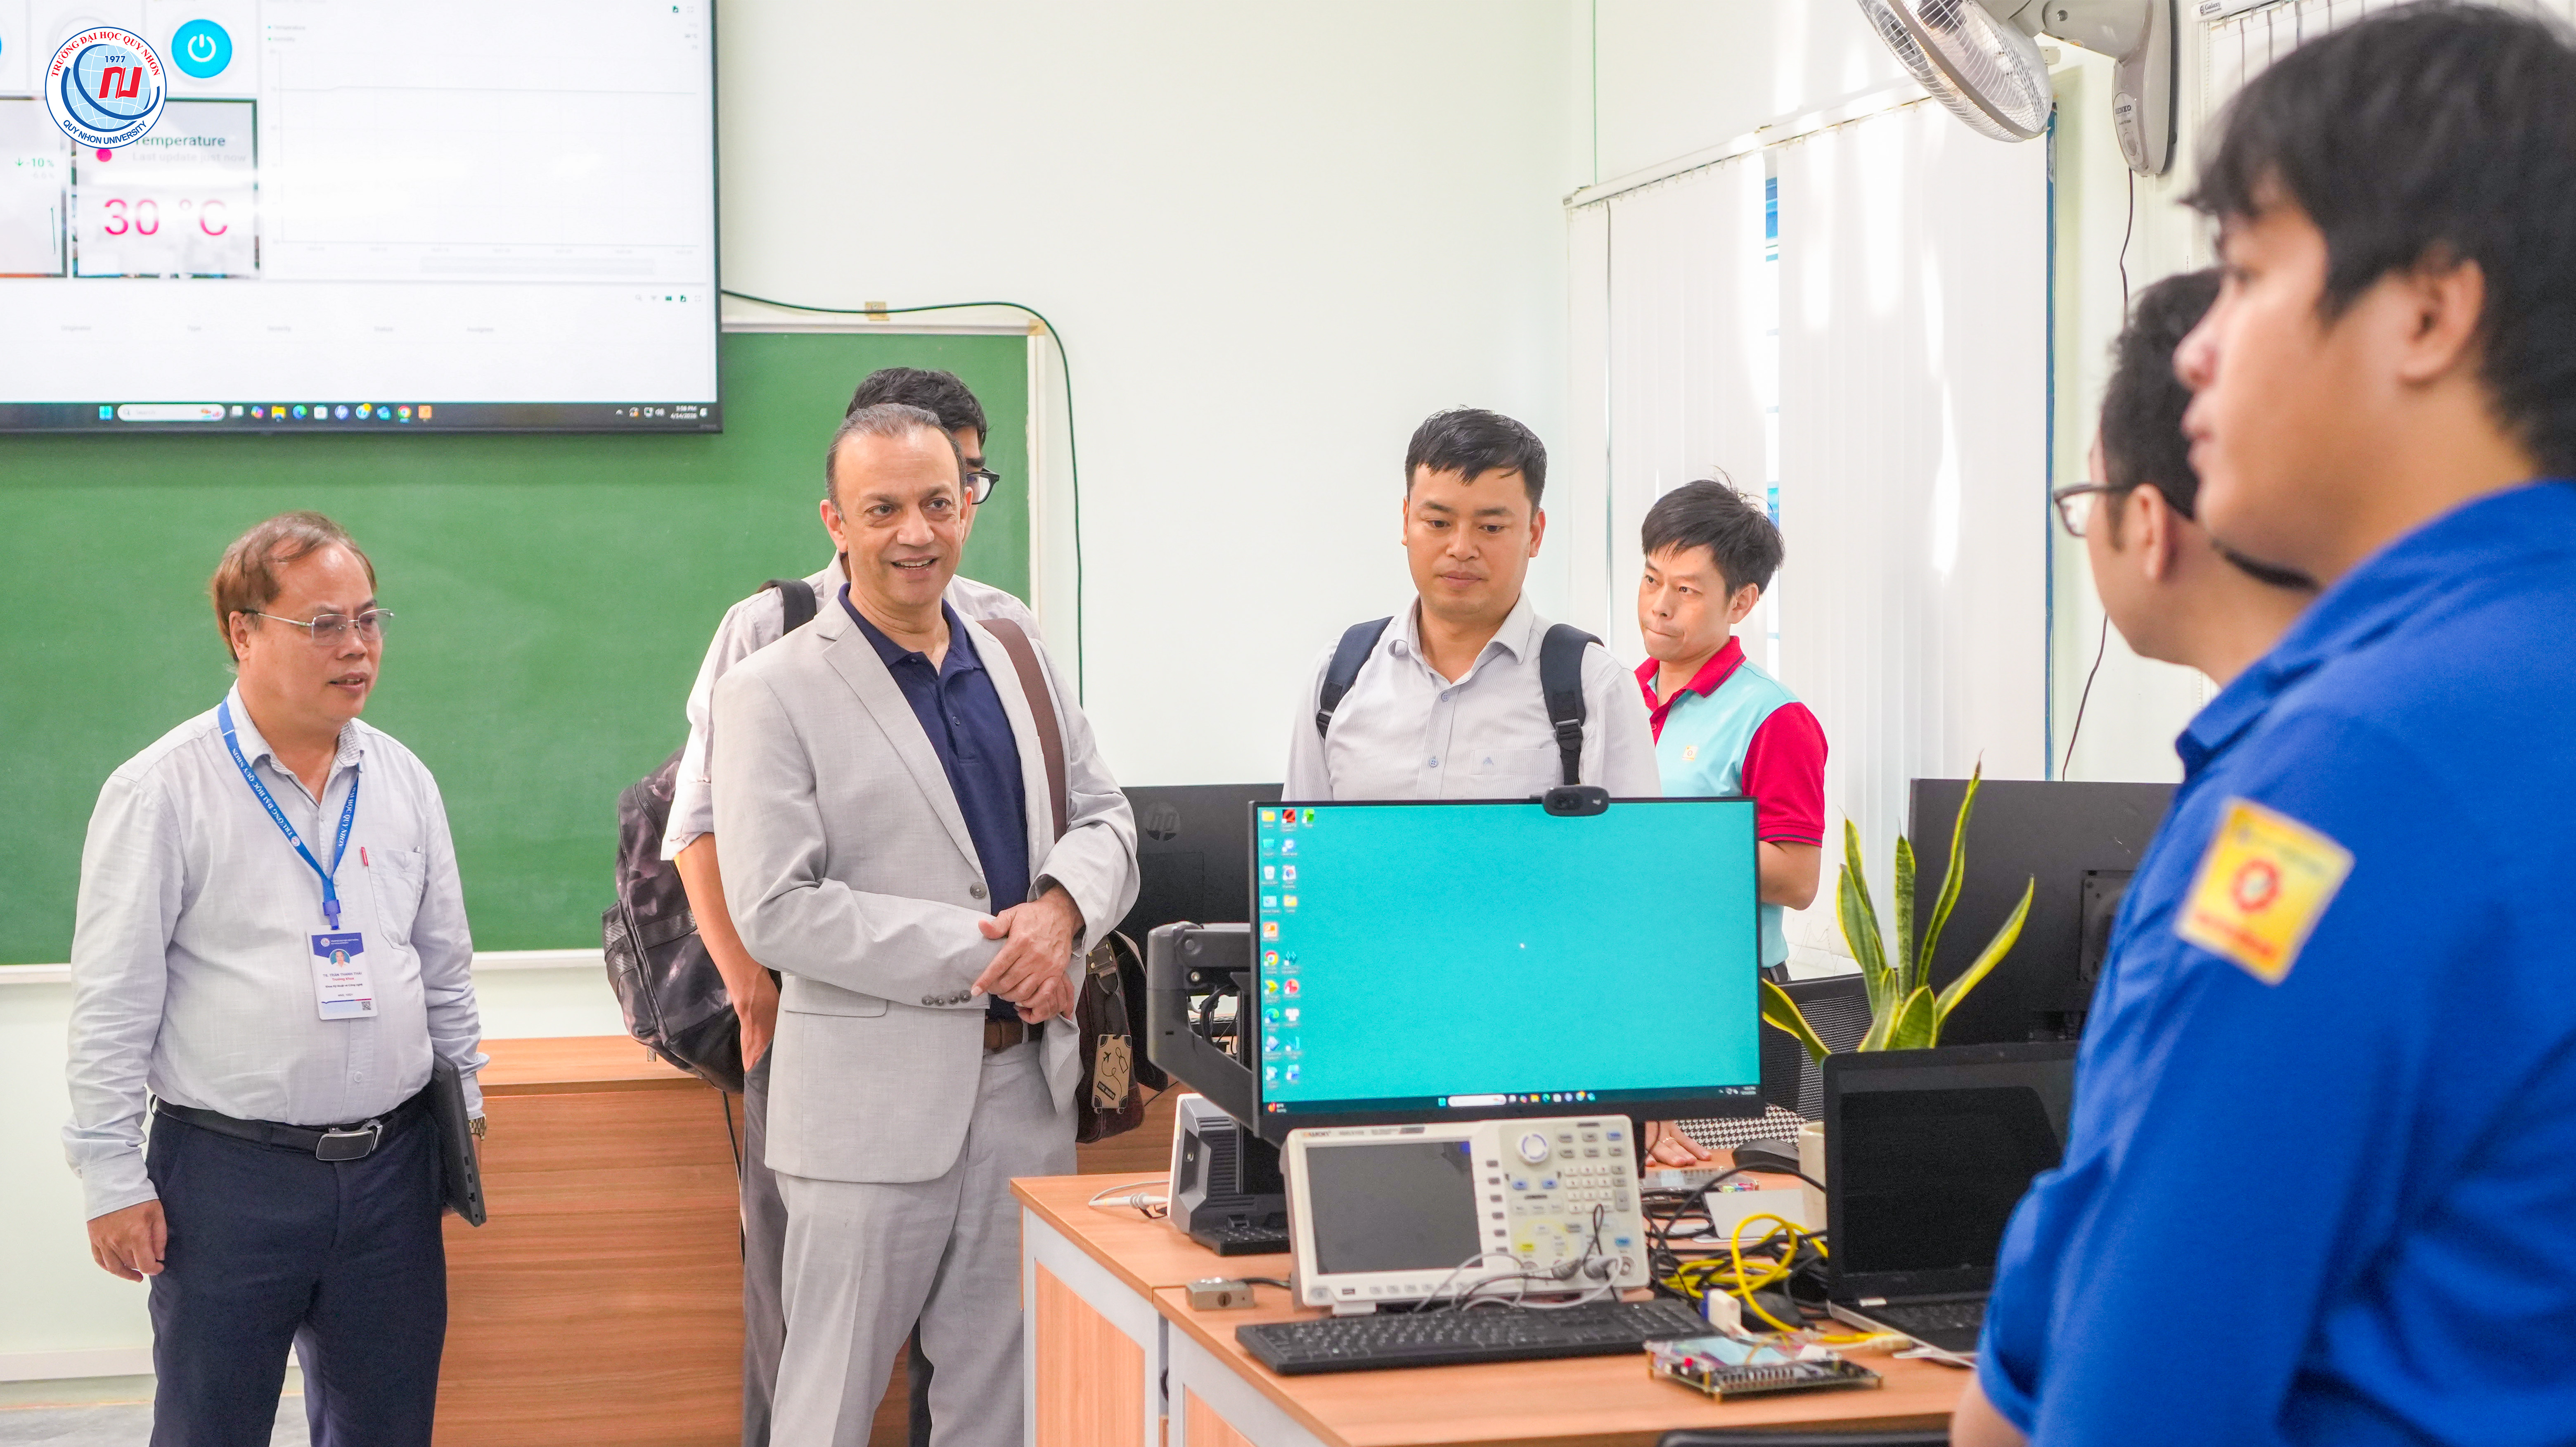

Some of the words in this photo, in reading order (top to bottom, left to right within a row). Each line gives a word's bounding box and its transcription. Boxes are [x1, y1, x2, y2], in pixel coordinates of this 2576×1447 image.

[2205, 2, 2221, 10] Galaxy
[133, 152, 156, 161] Last
[159, 152, 197, 163] update
[201, 153, 220, 163] just
[104, 198, 159, 236] 30
[179, 199, 228, 236] °C
[243, 768, 255, 782] QUY
